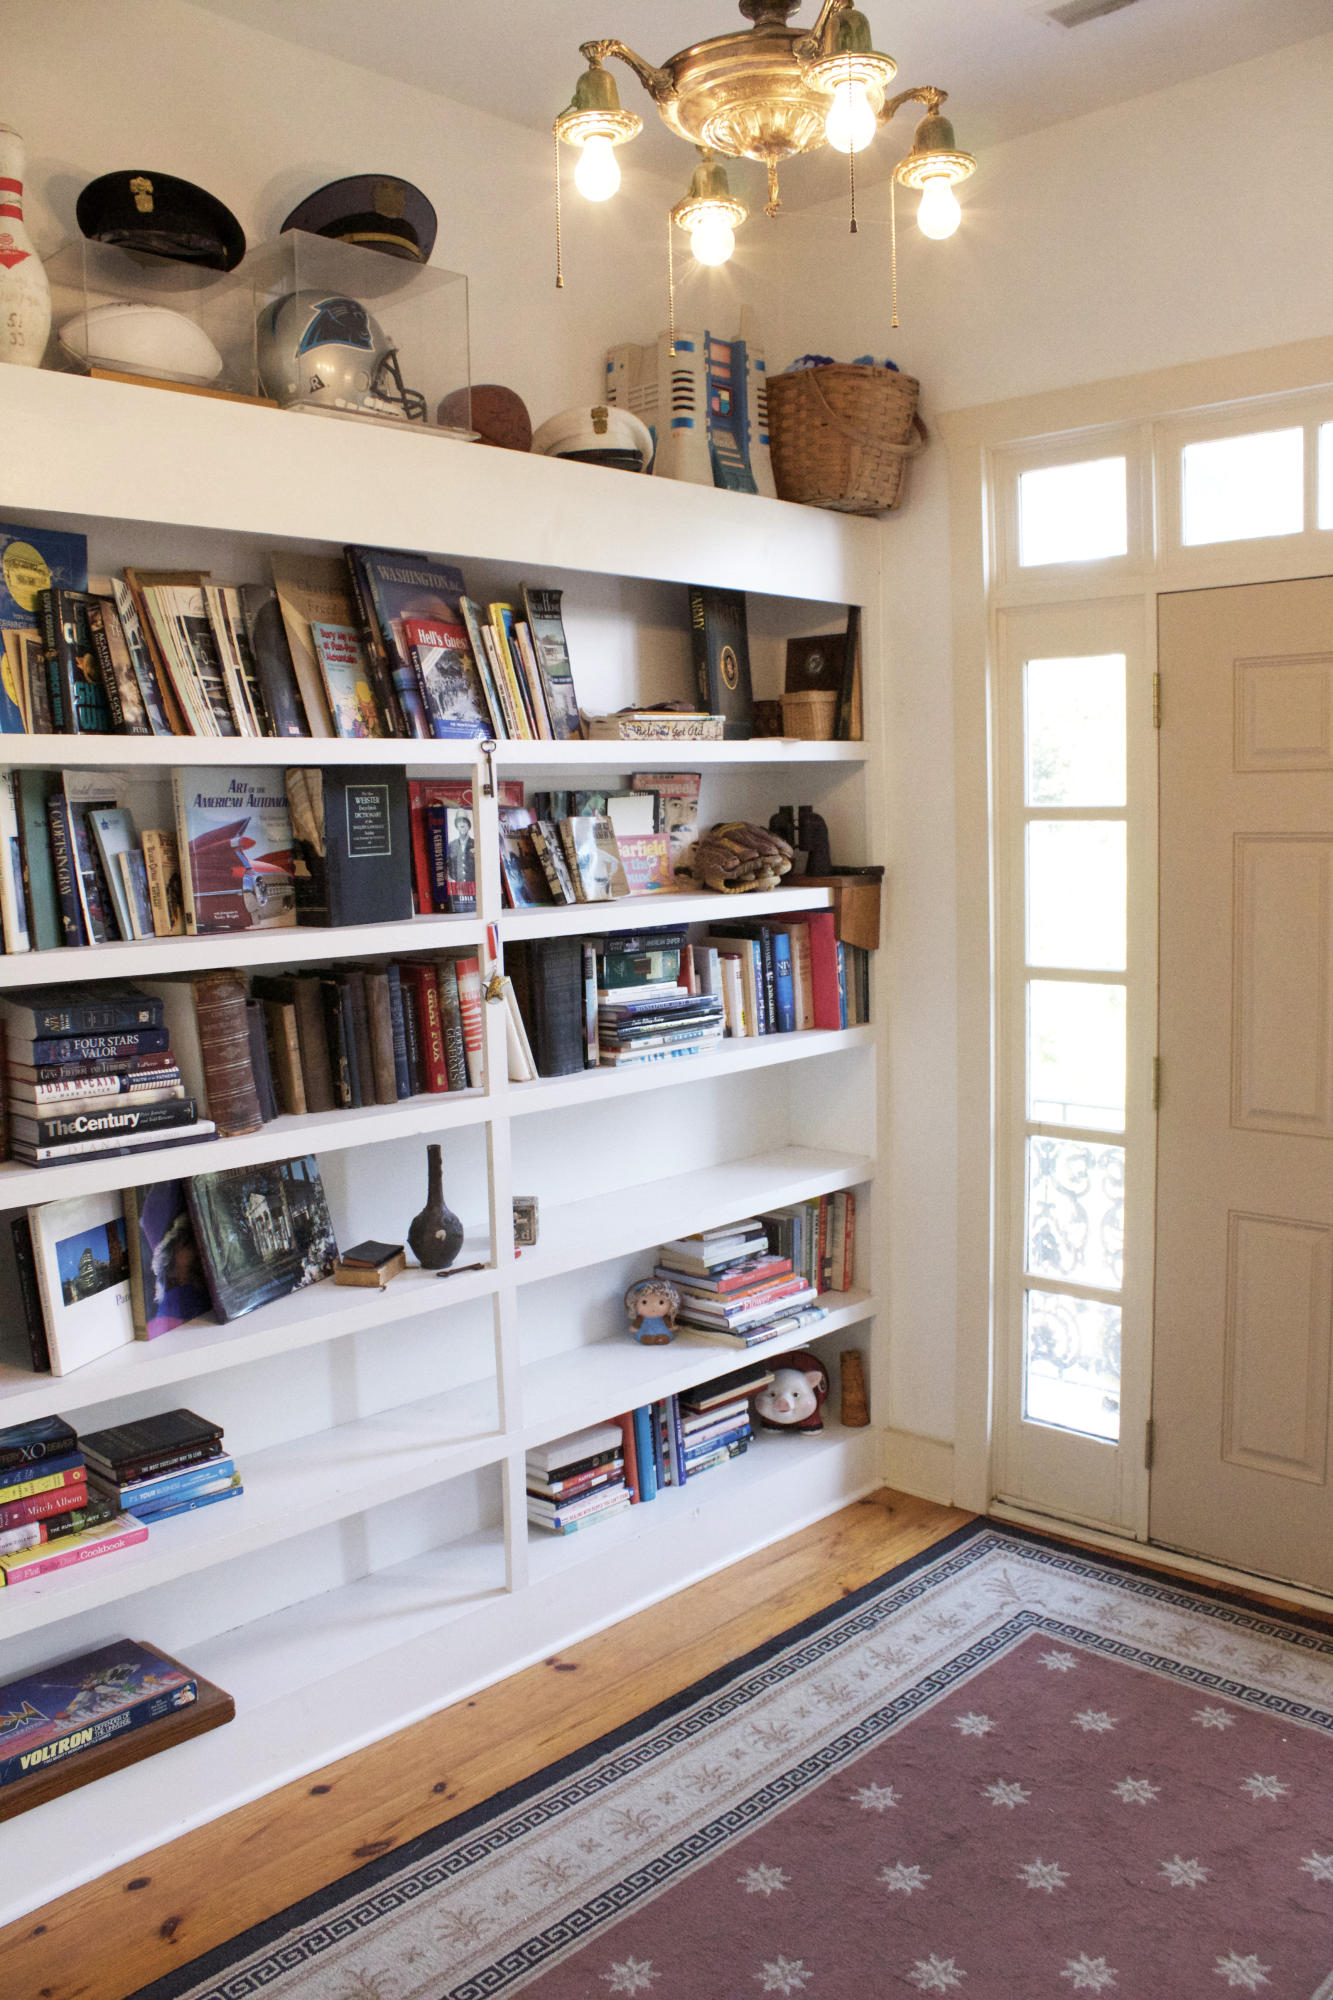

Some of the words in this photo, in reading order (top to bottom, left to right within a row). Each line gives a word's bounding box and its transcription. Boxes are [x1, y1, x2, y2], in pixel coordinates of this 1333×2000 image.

[377, 564, 449, 591] WASHINGTON
[43, 591, 52, 612] CLIVE
[689, 596, 707, 631] ARMY
[45, 614, 56, 646] CUSSLER
[417, 628, 444, 647] Hell's
[52, 661, 62, 694] SHOCK
[98, 632, 112, 672] AGAINST
[112, 696, 123, 724] GODS
[228, 779, 248, 793] ART
[194, 793, 242, 808] AMERICAN
[424, 988, 442, 1027] GRAY
[74, 1038, 105, 1050] FOUR
[107, 1034, 139, 1046] STARS
[81, 1047, 117, 1058] VALOR
[429, 1030, 446, 1062] FOX
[443, 1027, 462, 1081] GENERALS
[156, 1073, 177, 1081] FATHERS
[40, 1082, 70, 1094] JOHN
[60, 1090, 80, 1098] MARK
[84, 1086, 111, 1095] SALTER
[75, 1111, 140, 1133] Century
[139, 1489, 157, 1500] YOUR
[27, 1502, 53, 1516] Mitch
[55, 1495, 82, 1509] Album
[80, 1541, 125, 1559] Cookbook
[20, 1727, 93, 1770] VOLTRON
